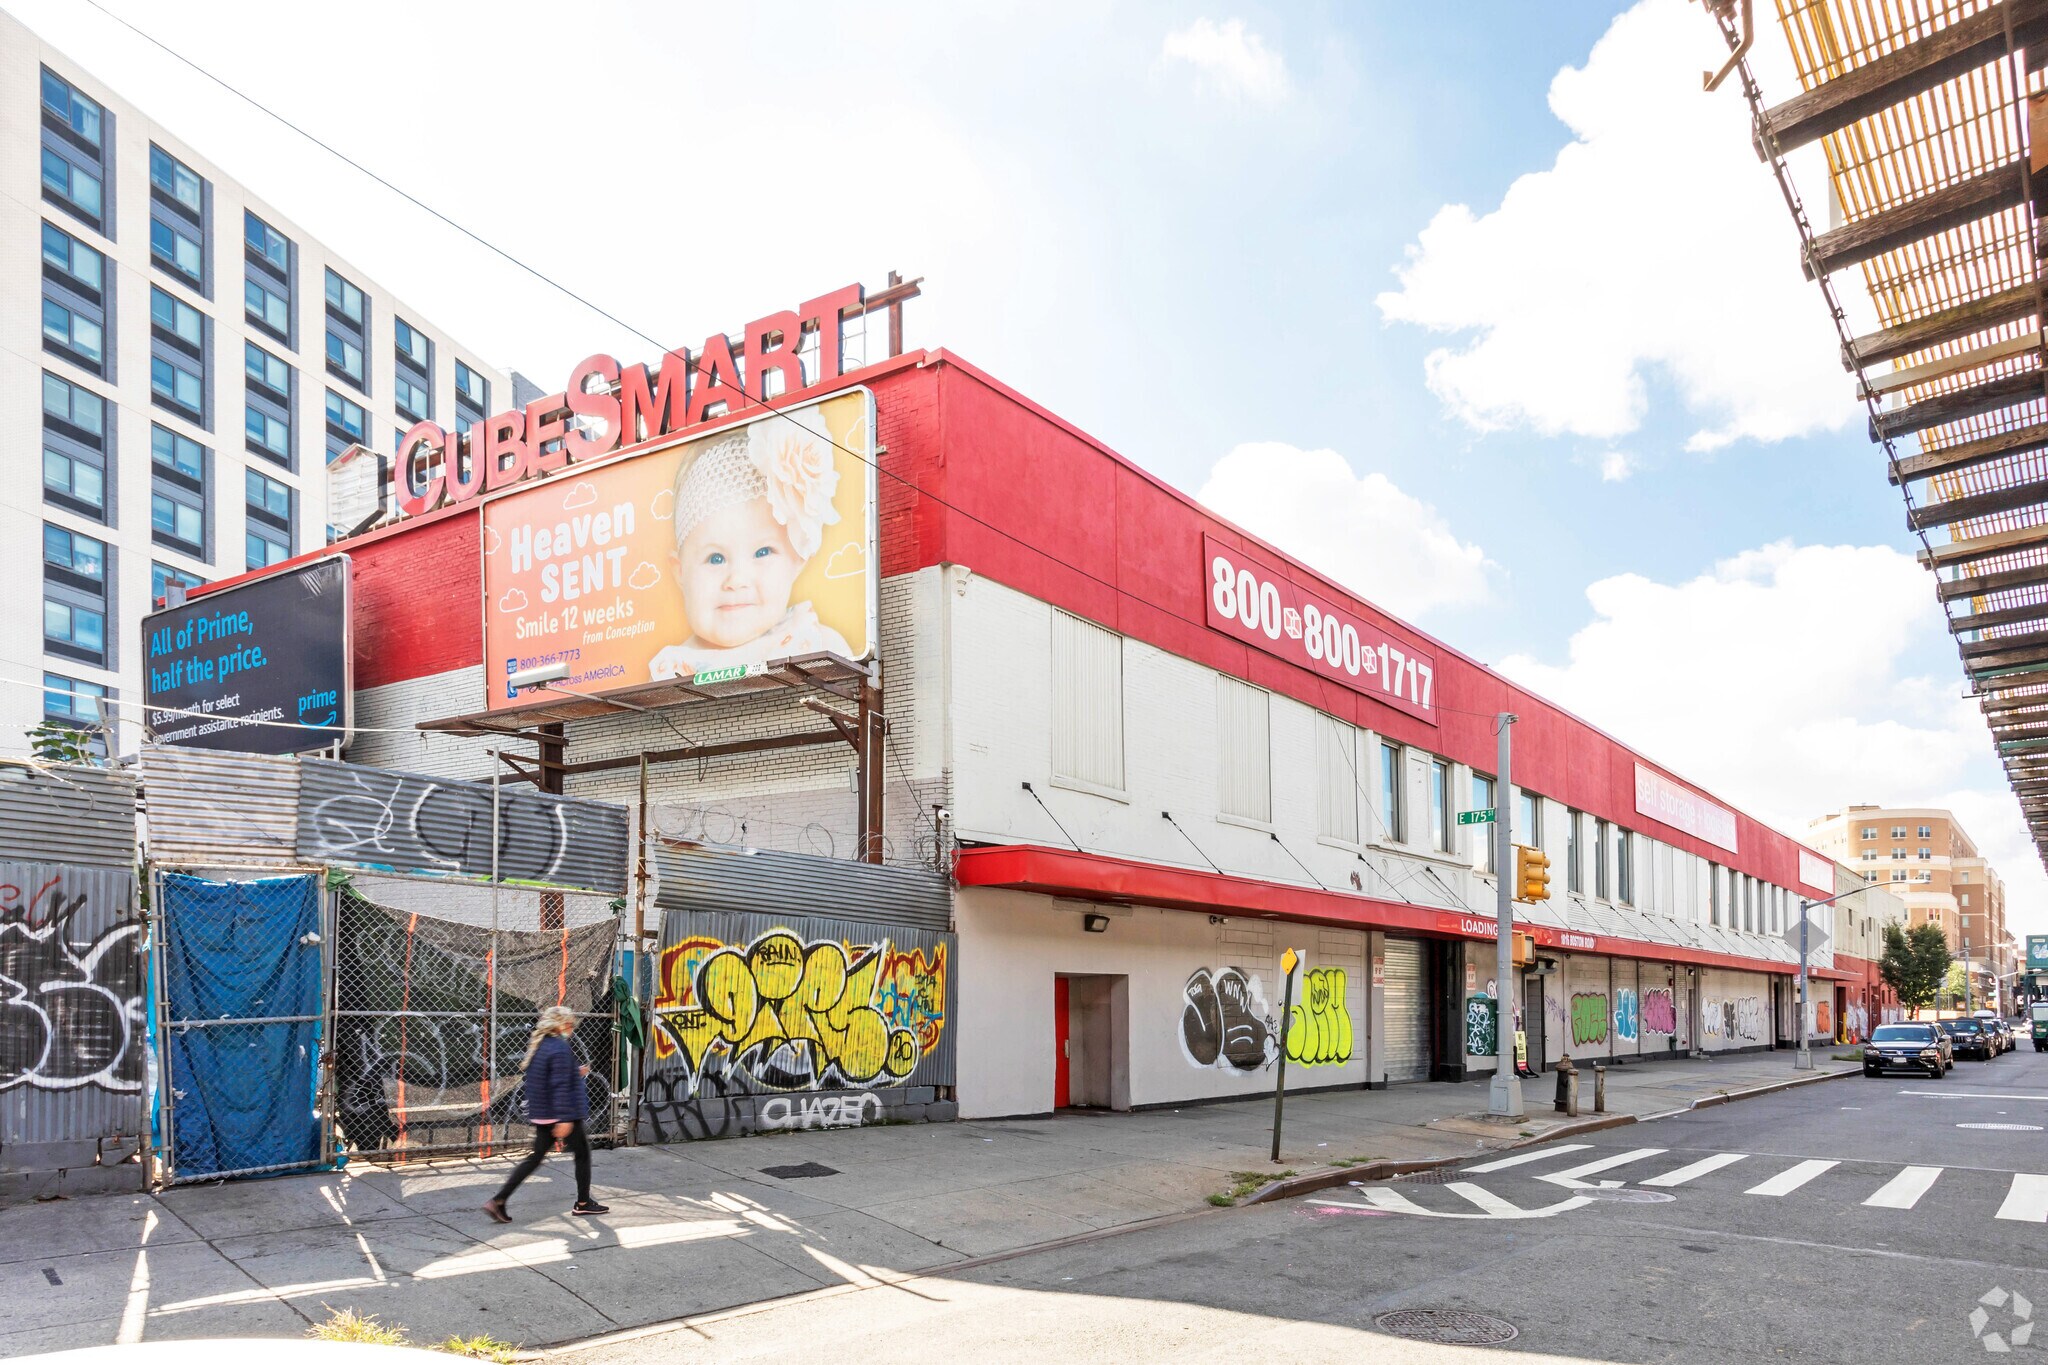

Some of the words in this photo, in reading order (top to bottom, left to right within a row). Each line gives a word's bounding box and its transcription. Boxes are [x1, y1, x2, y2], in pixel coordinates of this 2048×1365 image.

[511, 501, 635, 573] Heaven
[541, 546, 627, 603] SENT
[151, 627, 171, 658] All
[176, 619, 193, 650] of
[198, 610, 254, 645] Prime,
[516, 612, 558, 639] Smile
[561, 606, 579, 631] 12
[583, 596, 634, 625] weeks
[583, 631, 603, 645] from
[605, 620, 655, 639] Conception
[1212, 556, 1282, 640] 800
[1303, 603, 1361, 676] 800
[1377, 642, 1433, 710] 1717
[152, 661, 182, 693] half
[186, 656, 213, 685] the
[219, 644, 267, 683] price.
[520, 649, 580, 670] 800-366-7773
[698, 667, 742, 683] LAMAR
[202, 699, 215, 715] for
[216, 693, 240, 710] select
[298, 689, 337, 716] prime
[1460, 813, 1465, 824] E
[1471, 811, 1487, 823] 175
[1638, 777, 1657, 808] self
[1660, 788, 1697, 827] storage
[1461, 918, 1498, 936] LOADING
